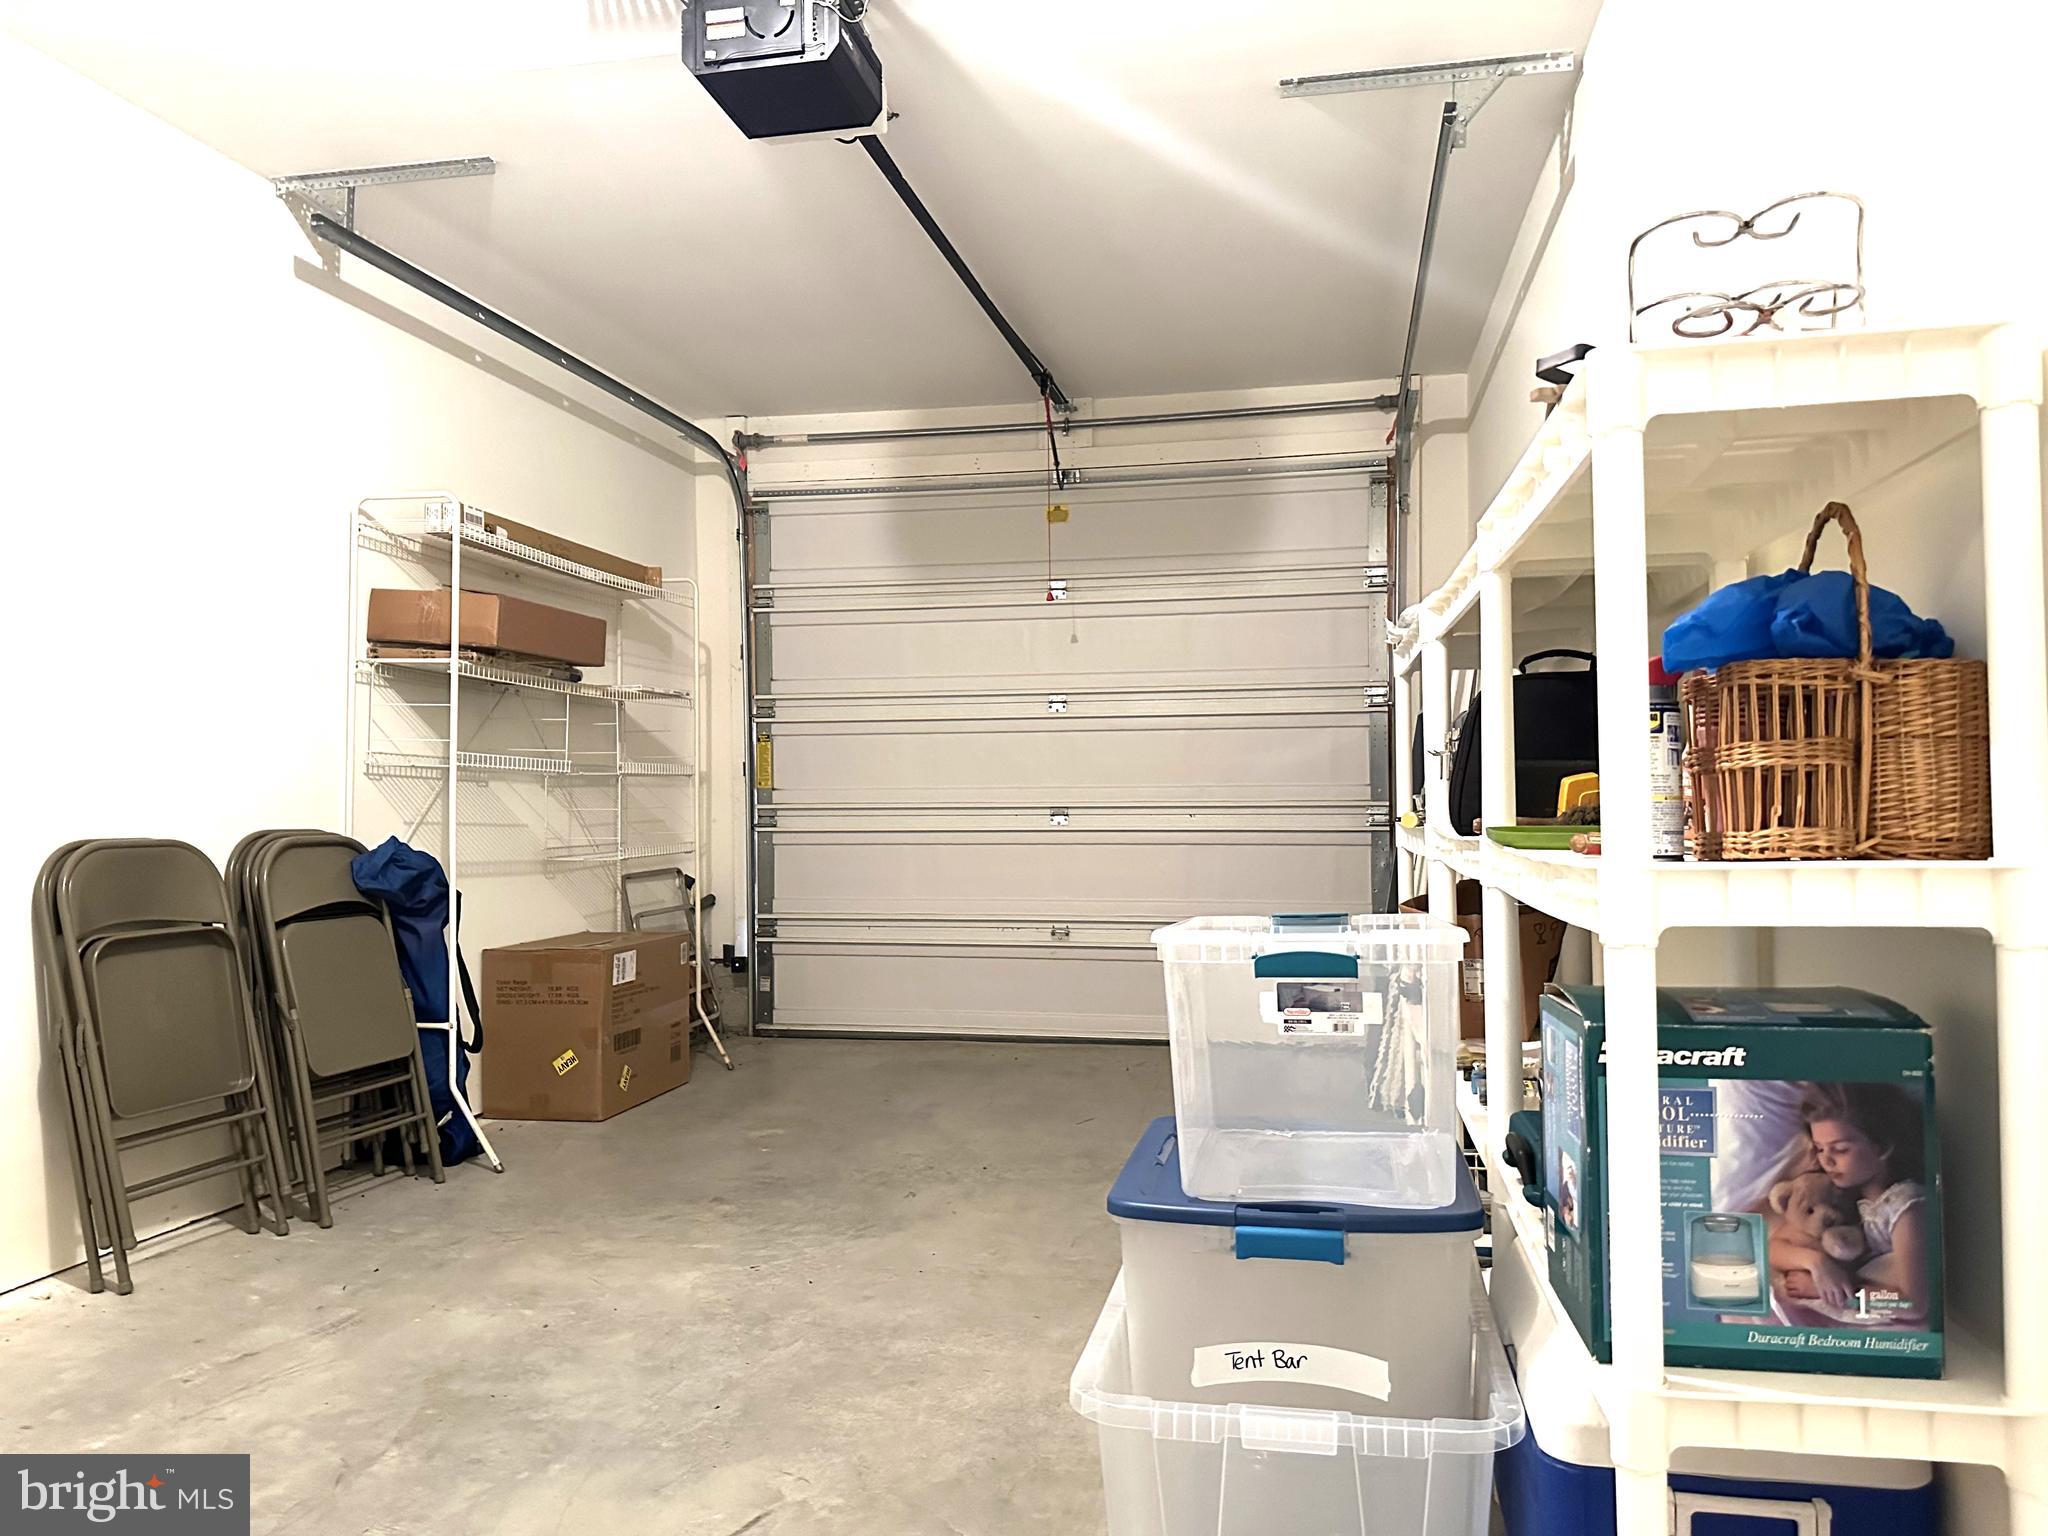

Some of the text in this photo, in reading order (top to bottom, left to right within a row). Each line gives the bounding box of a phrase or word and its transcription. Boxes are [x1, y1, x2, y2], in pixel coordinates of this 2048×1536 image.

[557, 1055, 577, 1074] HEAVY
[1662, 1106, 1690, 1121] OL
[1855, 1288, 1869, 1319] 1
[1869, 1289, 1899, 1301] gallon
[1747, 1331, 1930, 1353] Duracraft Bedroom Humidifier
[1224, 1349, 1308, 1370] Tent Bar
